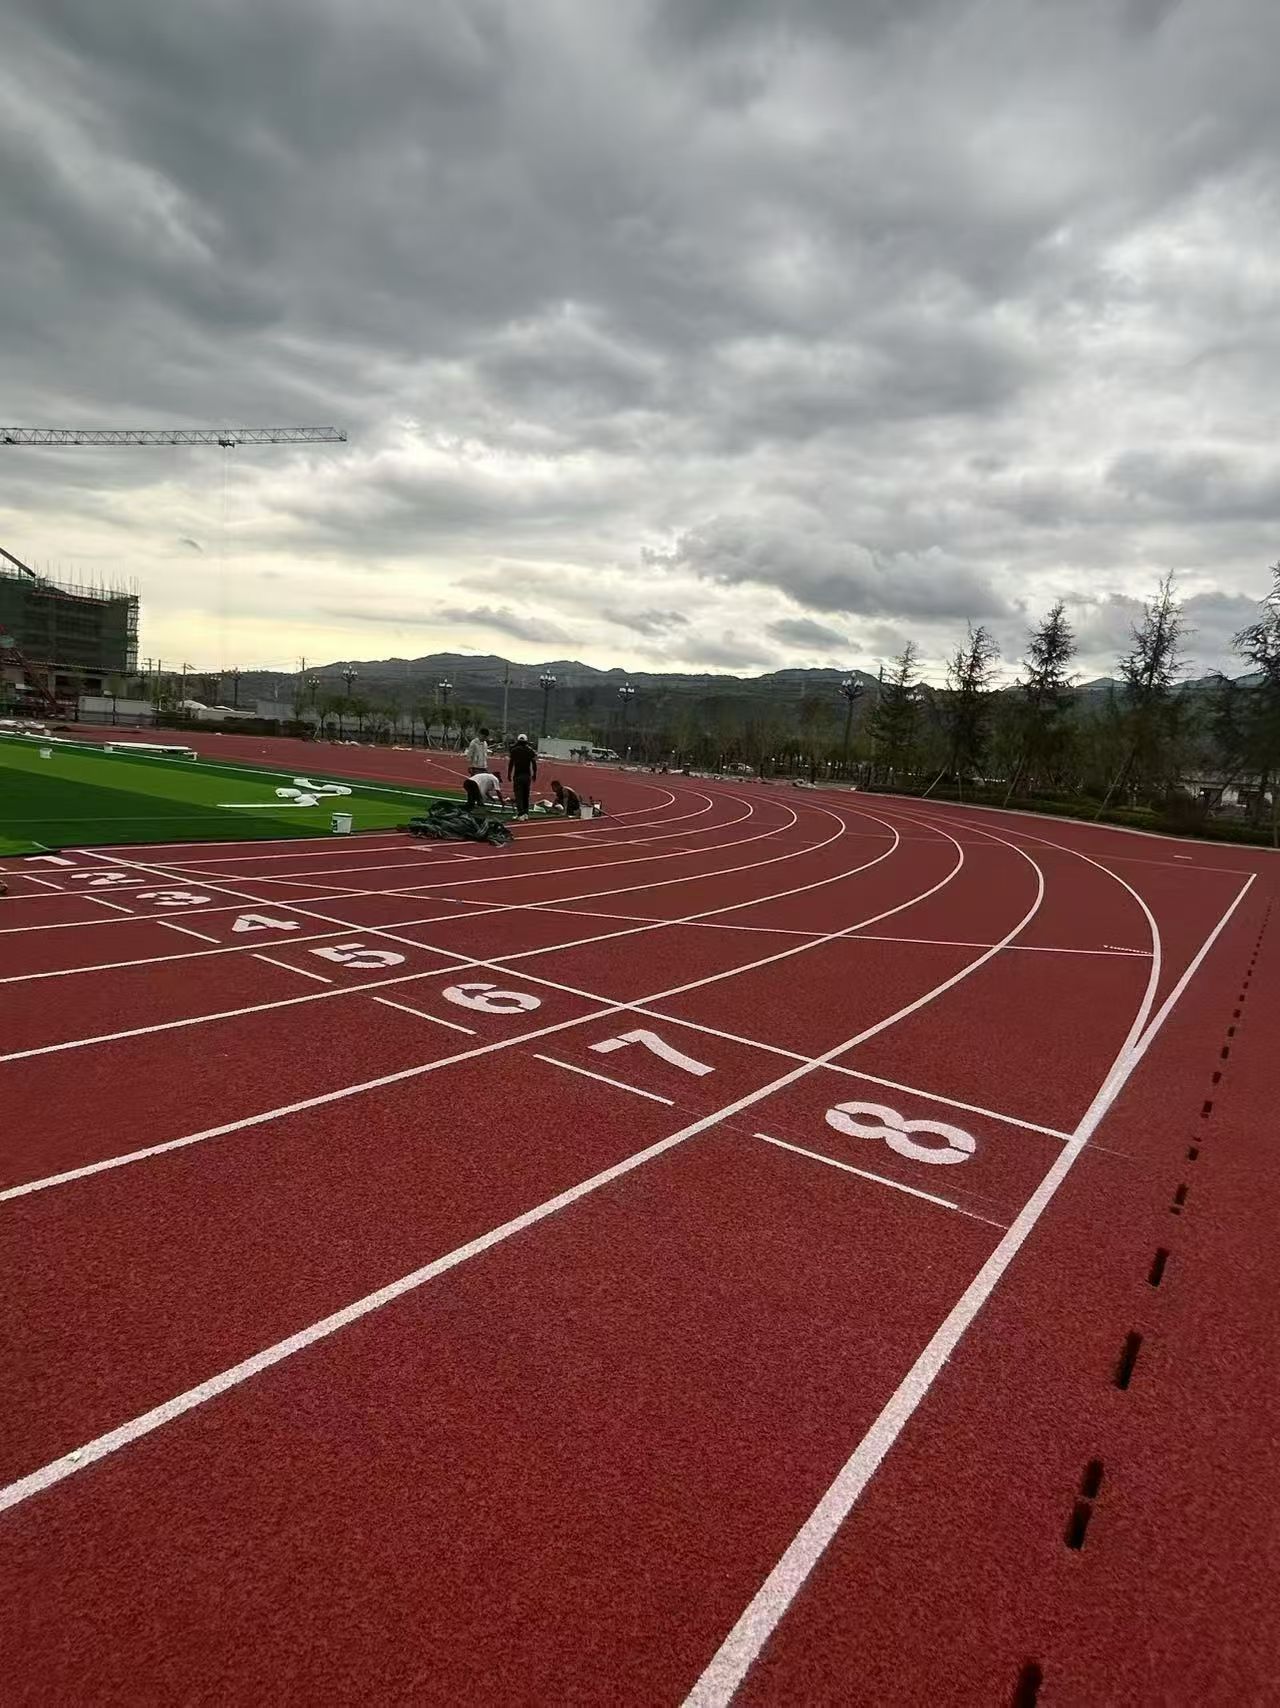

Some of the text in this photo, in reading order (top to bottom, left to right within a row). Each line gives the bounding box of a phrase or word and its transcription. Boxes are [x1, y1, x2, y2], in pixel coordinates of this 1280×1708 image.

[24, 856, 77, 866] 1
[71, 873, 145, 885] 2
[136, 891, 211, 906] 3
[231, 914, 301, 933] 4
[308, 943, 406, 969] 5
[442, 983, 541, 1014] 6
[588, 1029, 715, 1076] 7
[825, 1101, 976, 1165] 8
